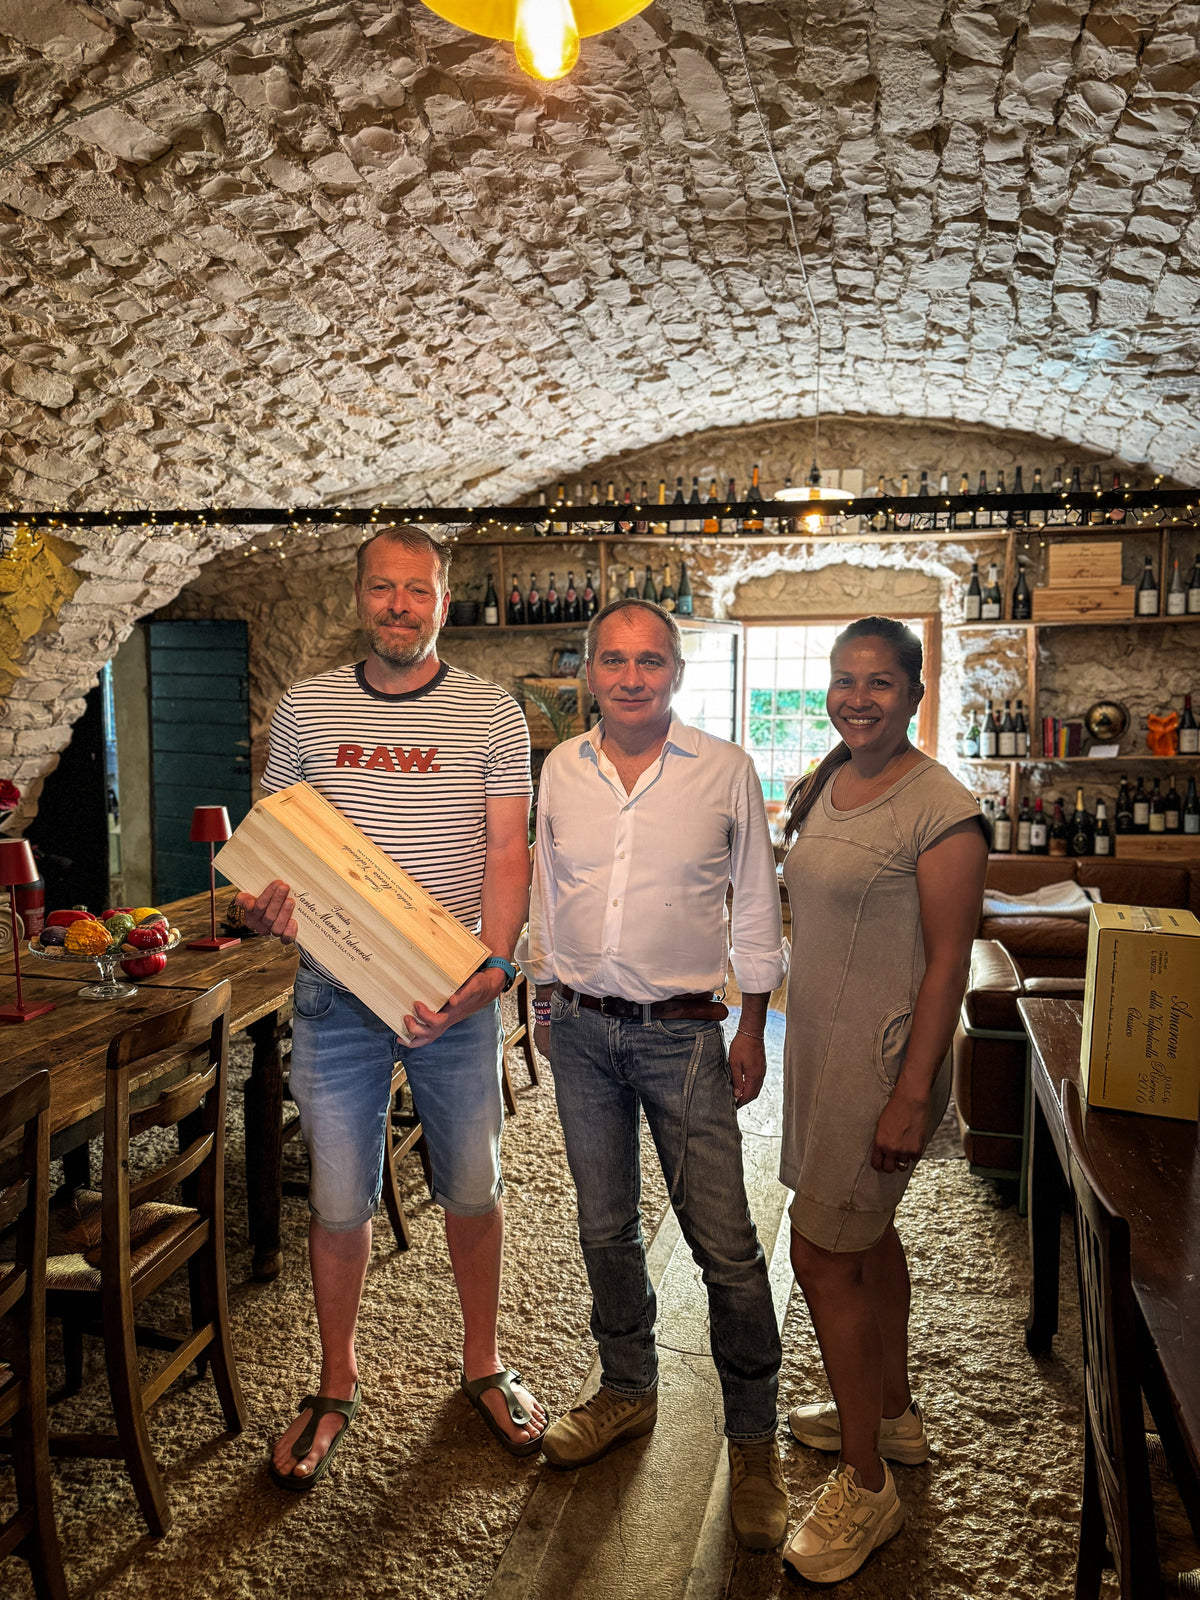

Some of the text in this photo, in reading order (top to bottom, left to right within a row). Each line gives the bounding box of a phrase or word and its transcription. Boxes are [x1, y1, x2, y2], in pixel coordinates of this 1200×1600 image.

[335, 744, 441, 773] RAW.
[373, 872, 397, 893] Maria
[331, 905, 351, 926] Tenuta
[396, 893, 417, 911] Santa
[294, 892, 373, 962] Santa Maria Valverde
[1126, 1007, 1142, 1037] Classico
[1142, 990, 1164, 1058] della Valpolicella
[1167, 996, 1193, 1059] Amarone
[1136, 1072, 1149, 1103] 2016
[1148, 1061, 1167, 1103] Riserva
